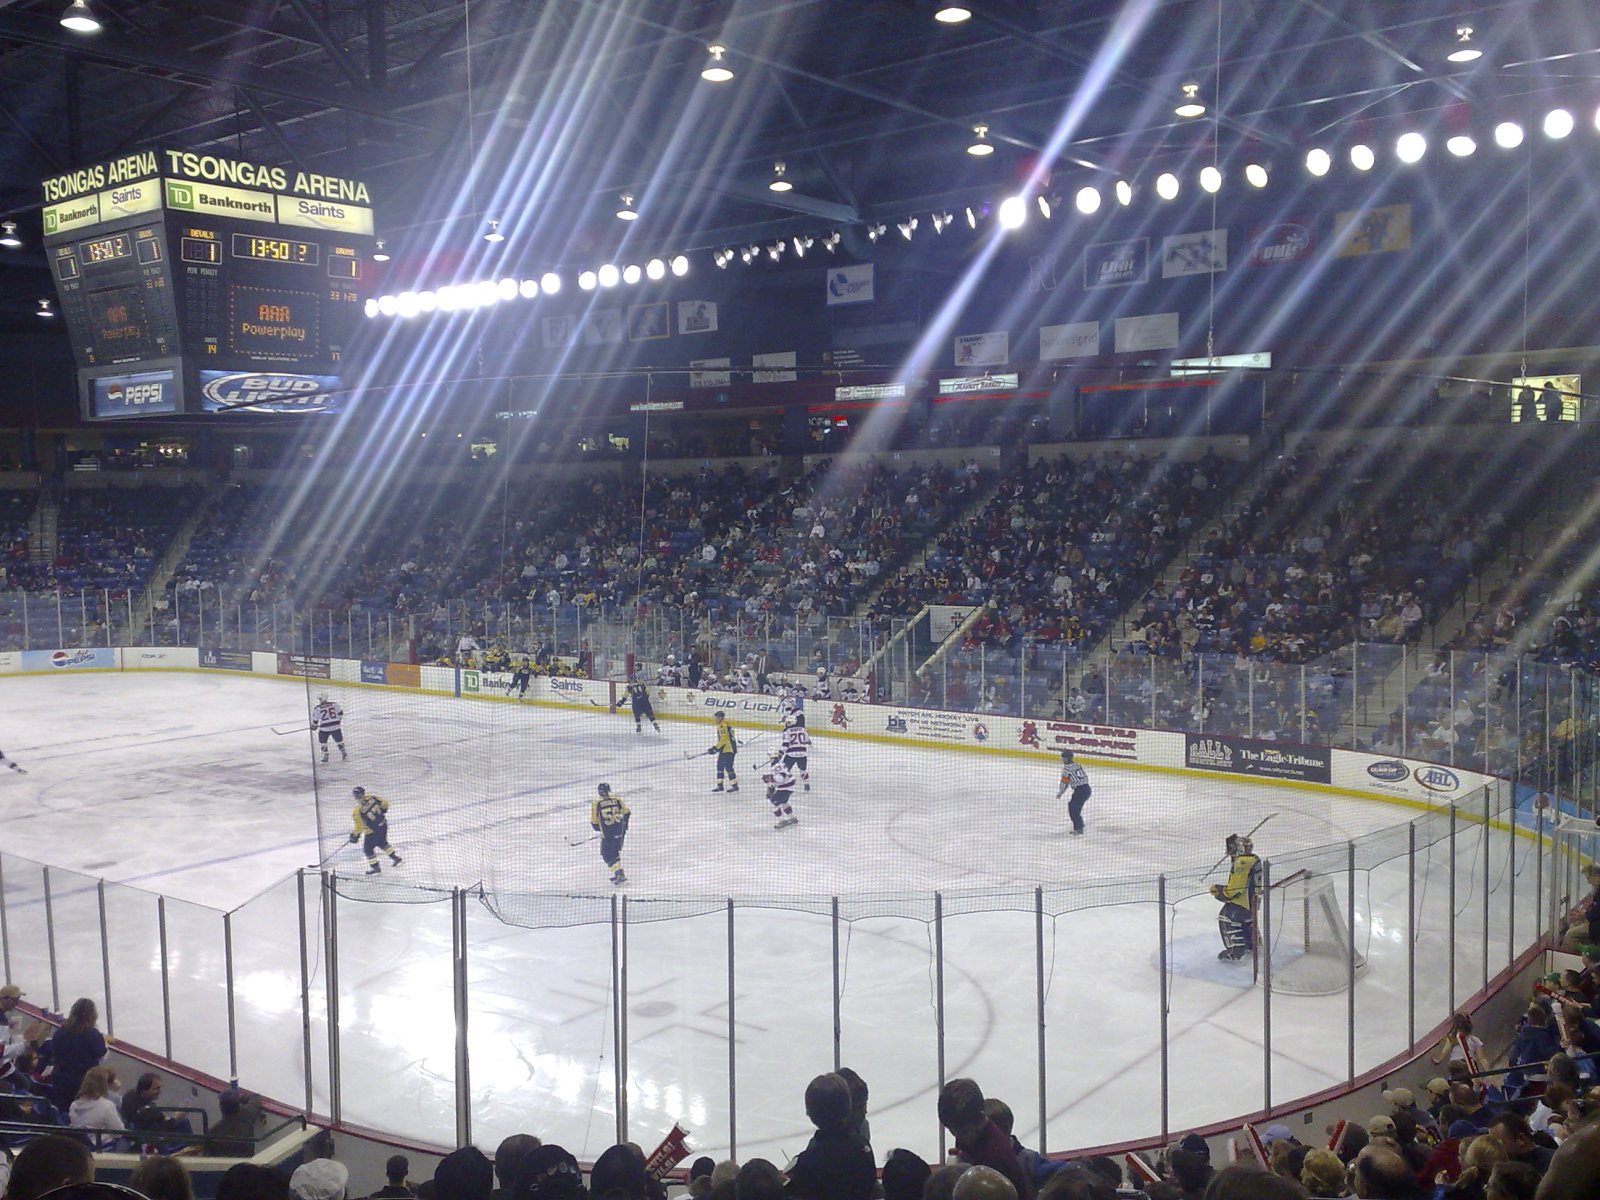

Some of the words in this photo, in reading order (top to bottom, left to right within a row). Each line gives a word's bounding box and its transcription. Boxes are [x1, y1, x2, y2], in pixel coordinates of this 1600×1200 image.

[42, 165, 104, 202] TSONGAS
[108, 151, 158, 184] ARENA
[166, 150, 287, 190] TSONGAS
[294, 172, 370, 204] ARENA
[112, 188, 142, 204] Saints
[170, 187, 191, 204] TD
[199, 194, 272, 214] Banknorth
[45, 214, 56, 228] TD
[60, 204, 97, 224] Banknorth
[298, 201, 345, 219] Saints
[210, 244, 214, 262] 1
[251, 239, 288, 260] 13:50
[352, 260, 356, 276] 1
[242, 322, 305, 341] Powerplay
[240, 378, 320, 392] BUD
[125, 383, 162, 405] PEPSI
[67, 653, 95, 666] PEPSI
[466, 674, 478, 688] TD
[551, 678, 583, 692] Saints
[704, 698, 736, 708] BUD
[744, 700, 784, 712] LIGH
[320, 708, 336, 720] 26
[1046, 722, 1092, 734] LOWELL
[1094, 727, 1136, 738] DEVILS
[790, 732, 806, 745] 20
[1190, 740, 1232, 760] RALLY
[1240, 749, 1259, 760] The
[1422, 770, 1452, 786] AHL
